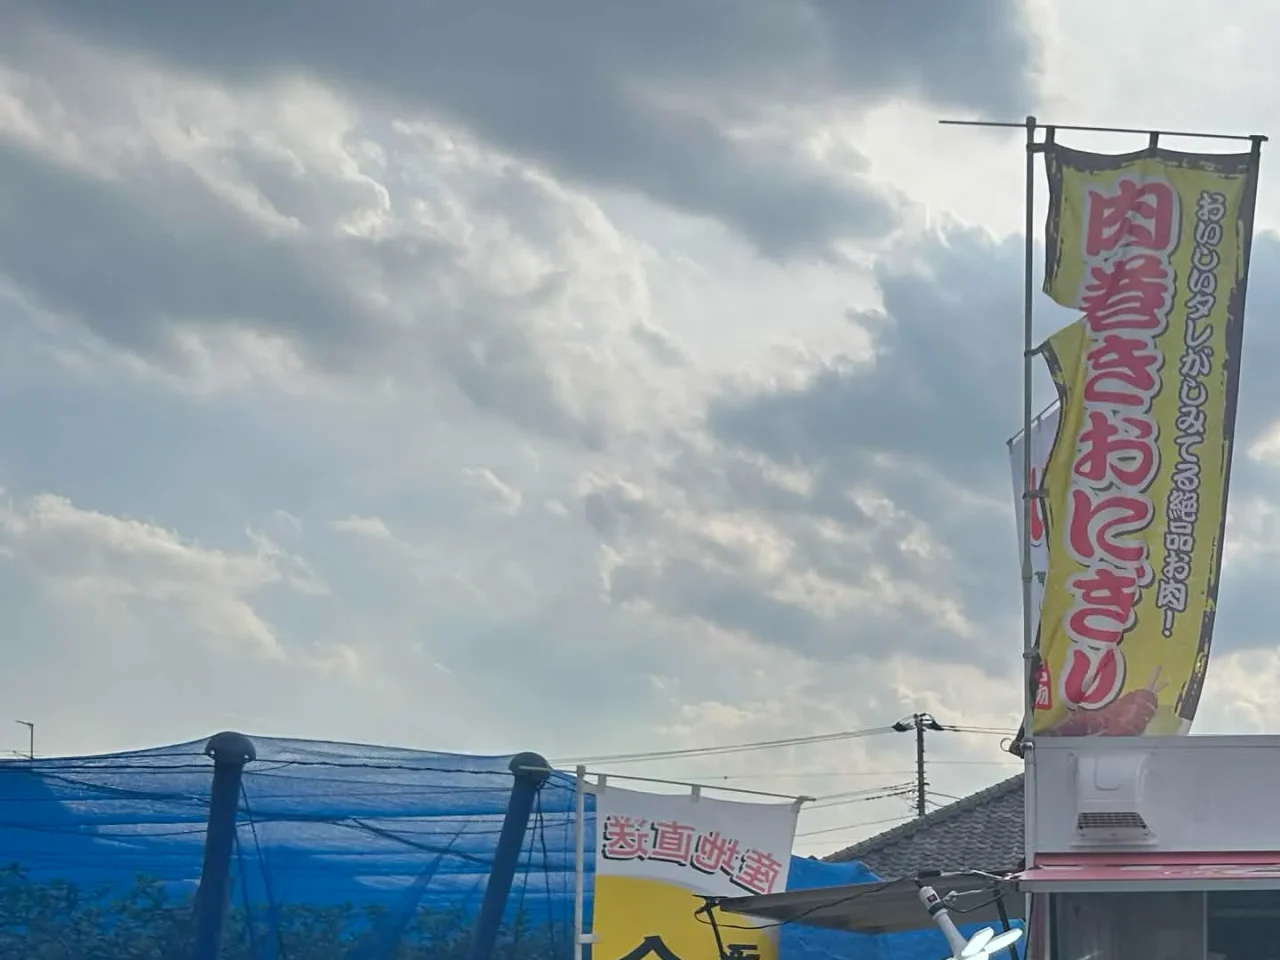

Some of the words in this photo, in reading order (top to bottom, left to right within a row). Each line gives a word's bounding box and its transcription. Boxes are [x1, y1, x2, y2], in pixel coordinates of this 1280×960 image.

[1064, 176, 1181, 711] 肉巻きおにぎり
